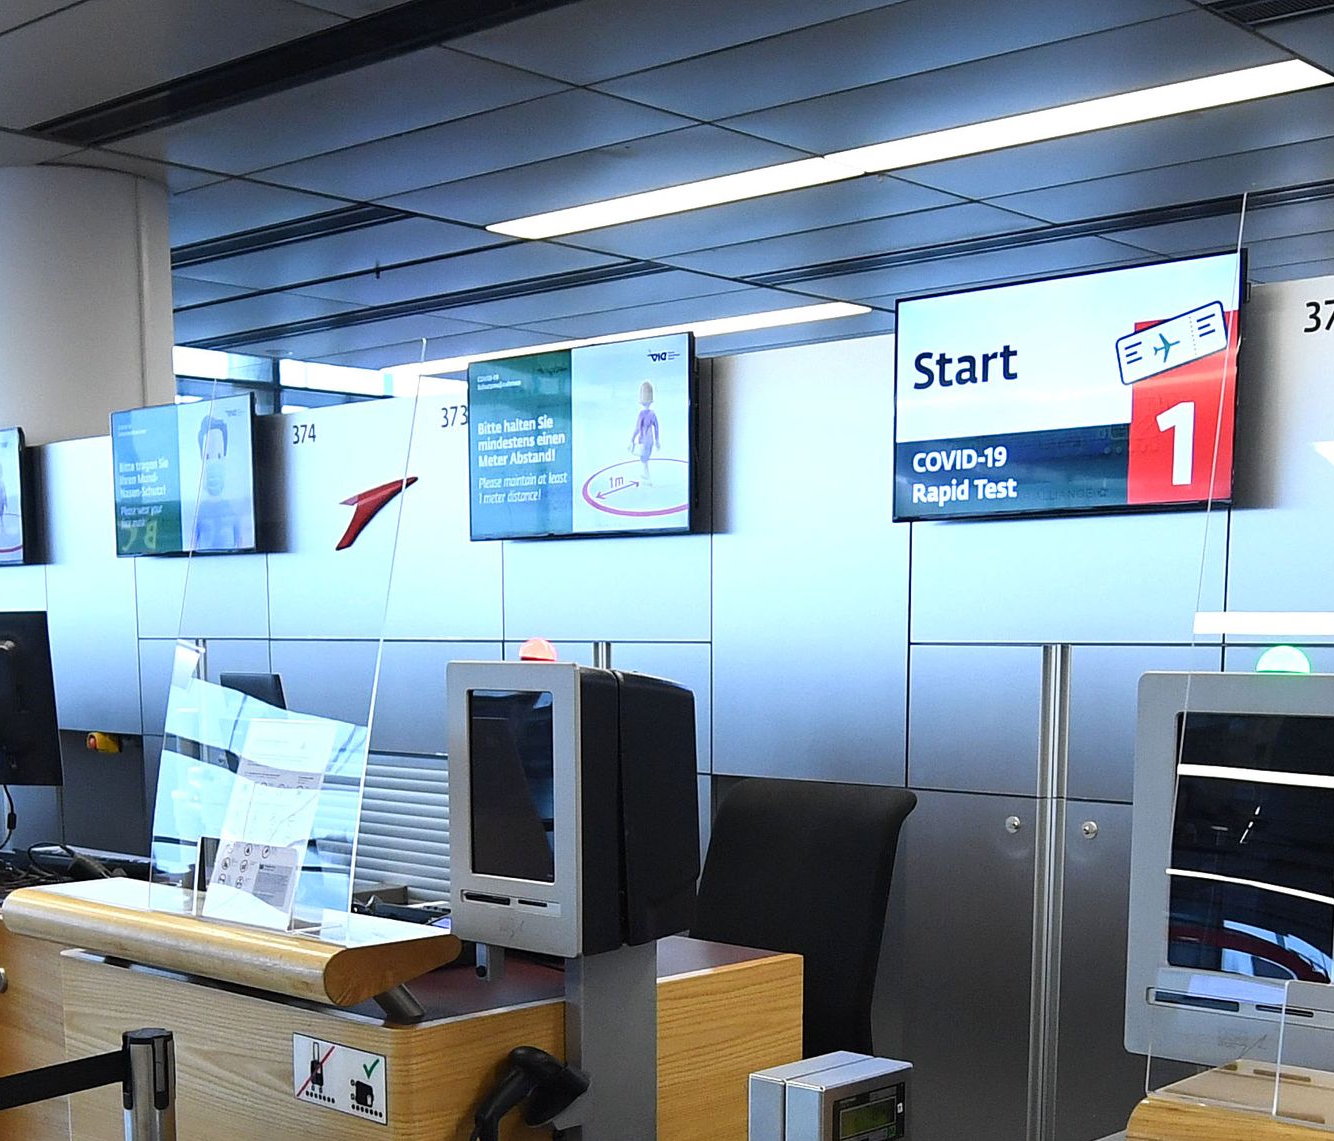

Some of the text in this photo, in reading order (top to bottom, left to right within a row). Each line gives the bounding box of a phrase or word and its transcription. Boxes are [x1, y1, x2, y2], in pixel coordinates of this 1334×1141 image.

[913, 344, 1018, 390] Start
[441, 404, 468, 427] 373
[478, 414, 553, 435] Bitte halten Sie
[292, 424, 316, 444] 374
[478, 432, 565, 451] mindestens einen
[1156, 401, 1195, 485] 1
[478, 448, 555, 467] Meter Abstand!
[912, 446, 1007, 473] COVID-19
[912, 481, 969, 508] Rapid
[973, 477, 1018, 500] Test
